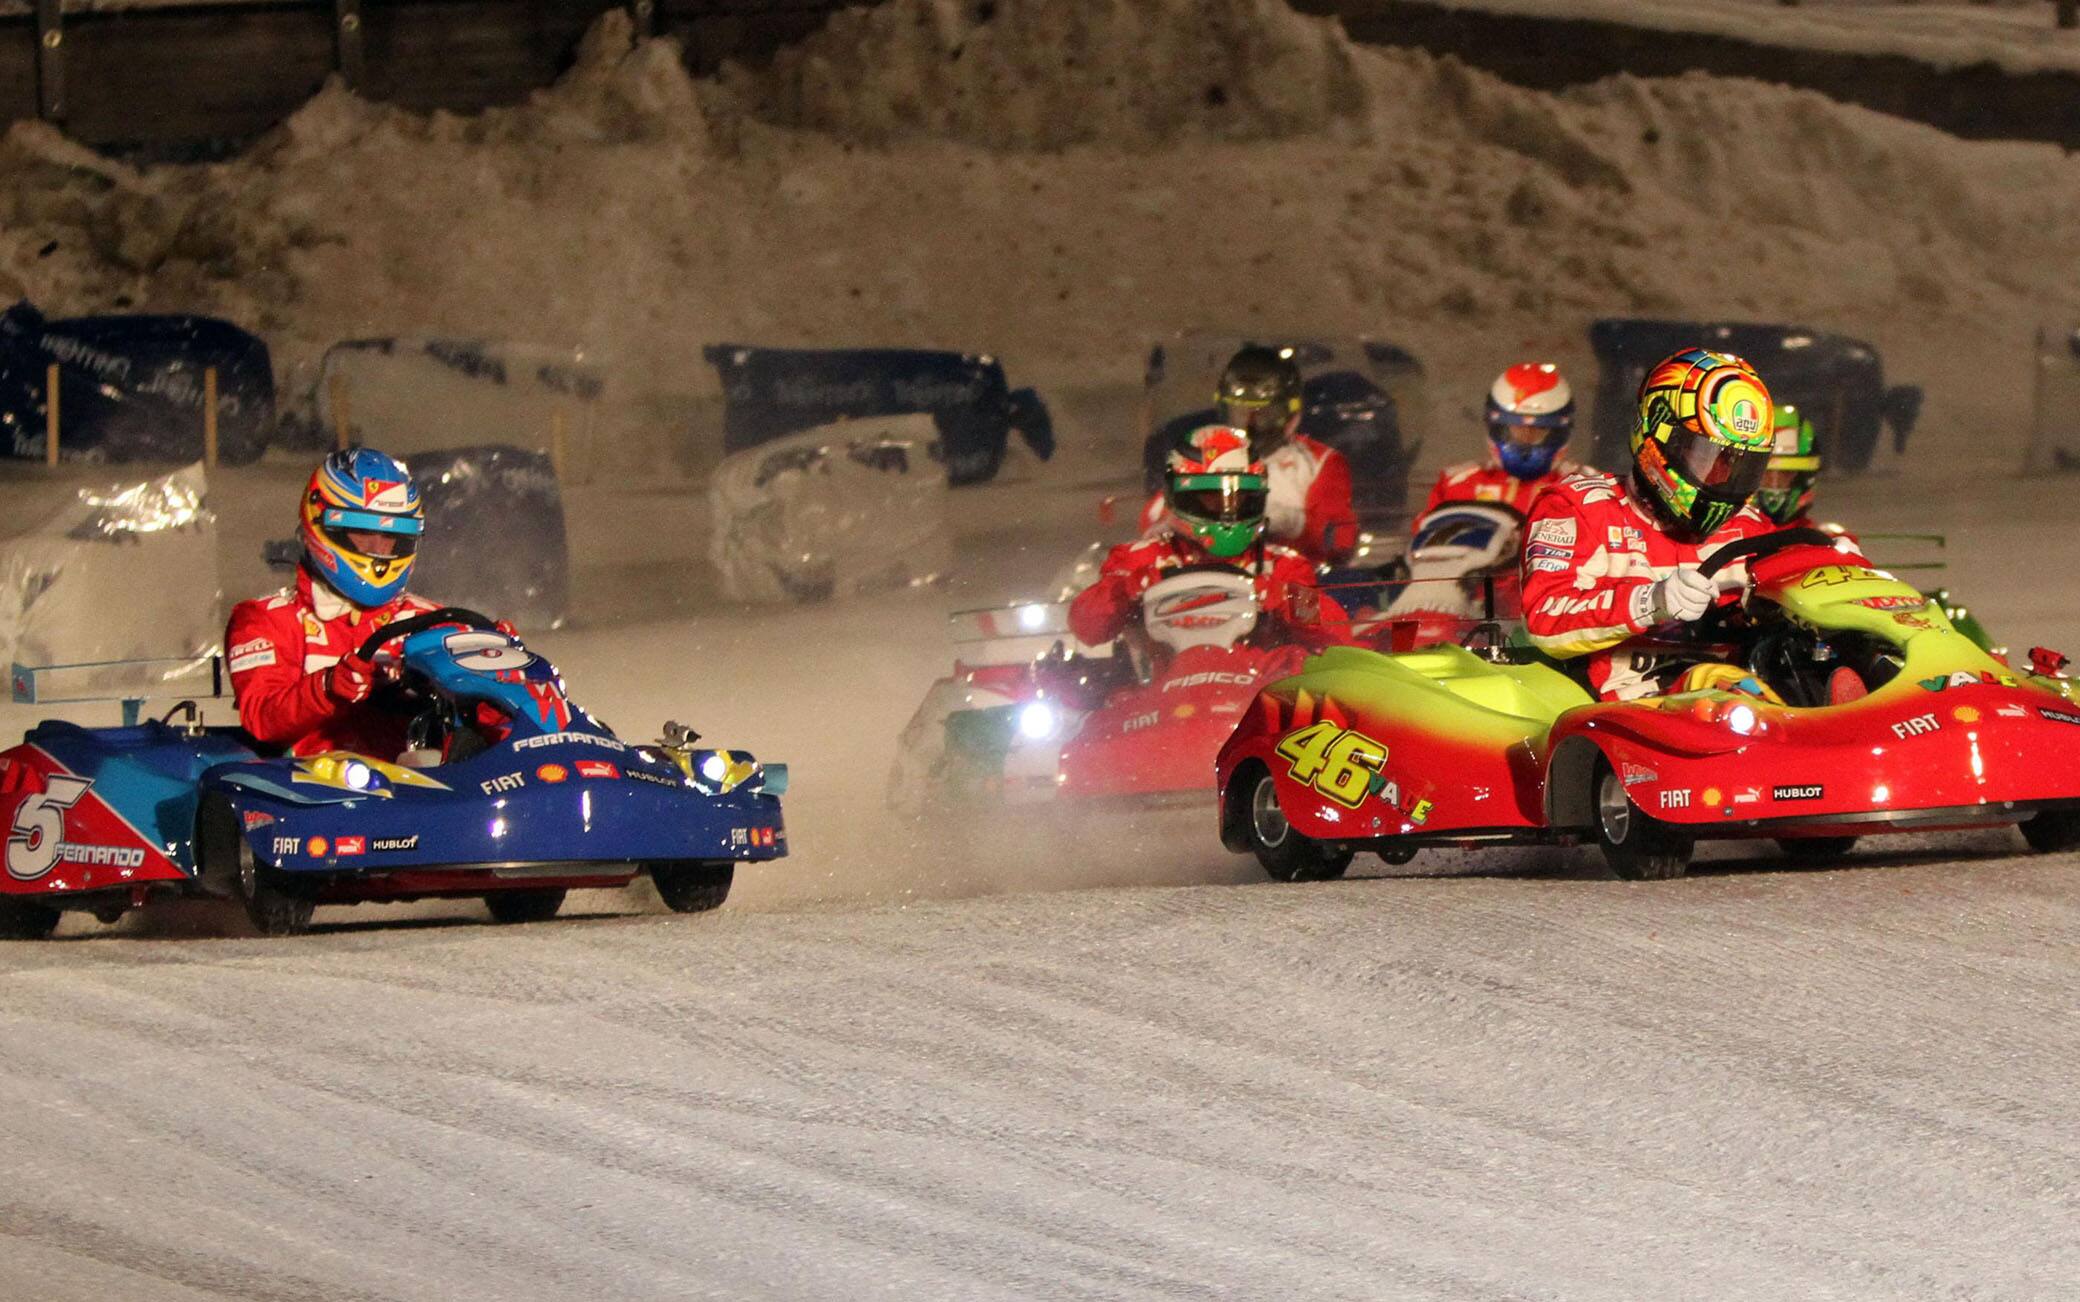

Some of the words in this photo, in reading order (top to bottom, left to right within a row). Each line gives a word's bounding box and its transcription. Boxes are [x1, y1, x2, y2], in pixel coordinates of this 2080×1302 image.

[1162, 672, 1254, 693] FISICO
[1918, 671, 2019, 692] VALE
[1123, 710, 1159, 733] FIAT
[1890, 713, 1941, 740] FIAT
[513, 731, 625, 752] FERNANDO
[1275, 720, 1389, 809] 46
[480, 771, 526, 796] FIAT
[1774, 786, 1823, 799] HUBLOT
[1660, 788, 1692, 809] FIAT
[6, 773, 96, 880] 5
[272, 837, 301, 855] FIAT
[373, 837, 418, 850] HUBLOT
[54, 842, 146, 867] FERNANDO
